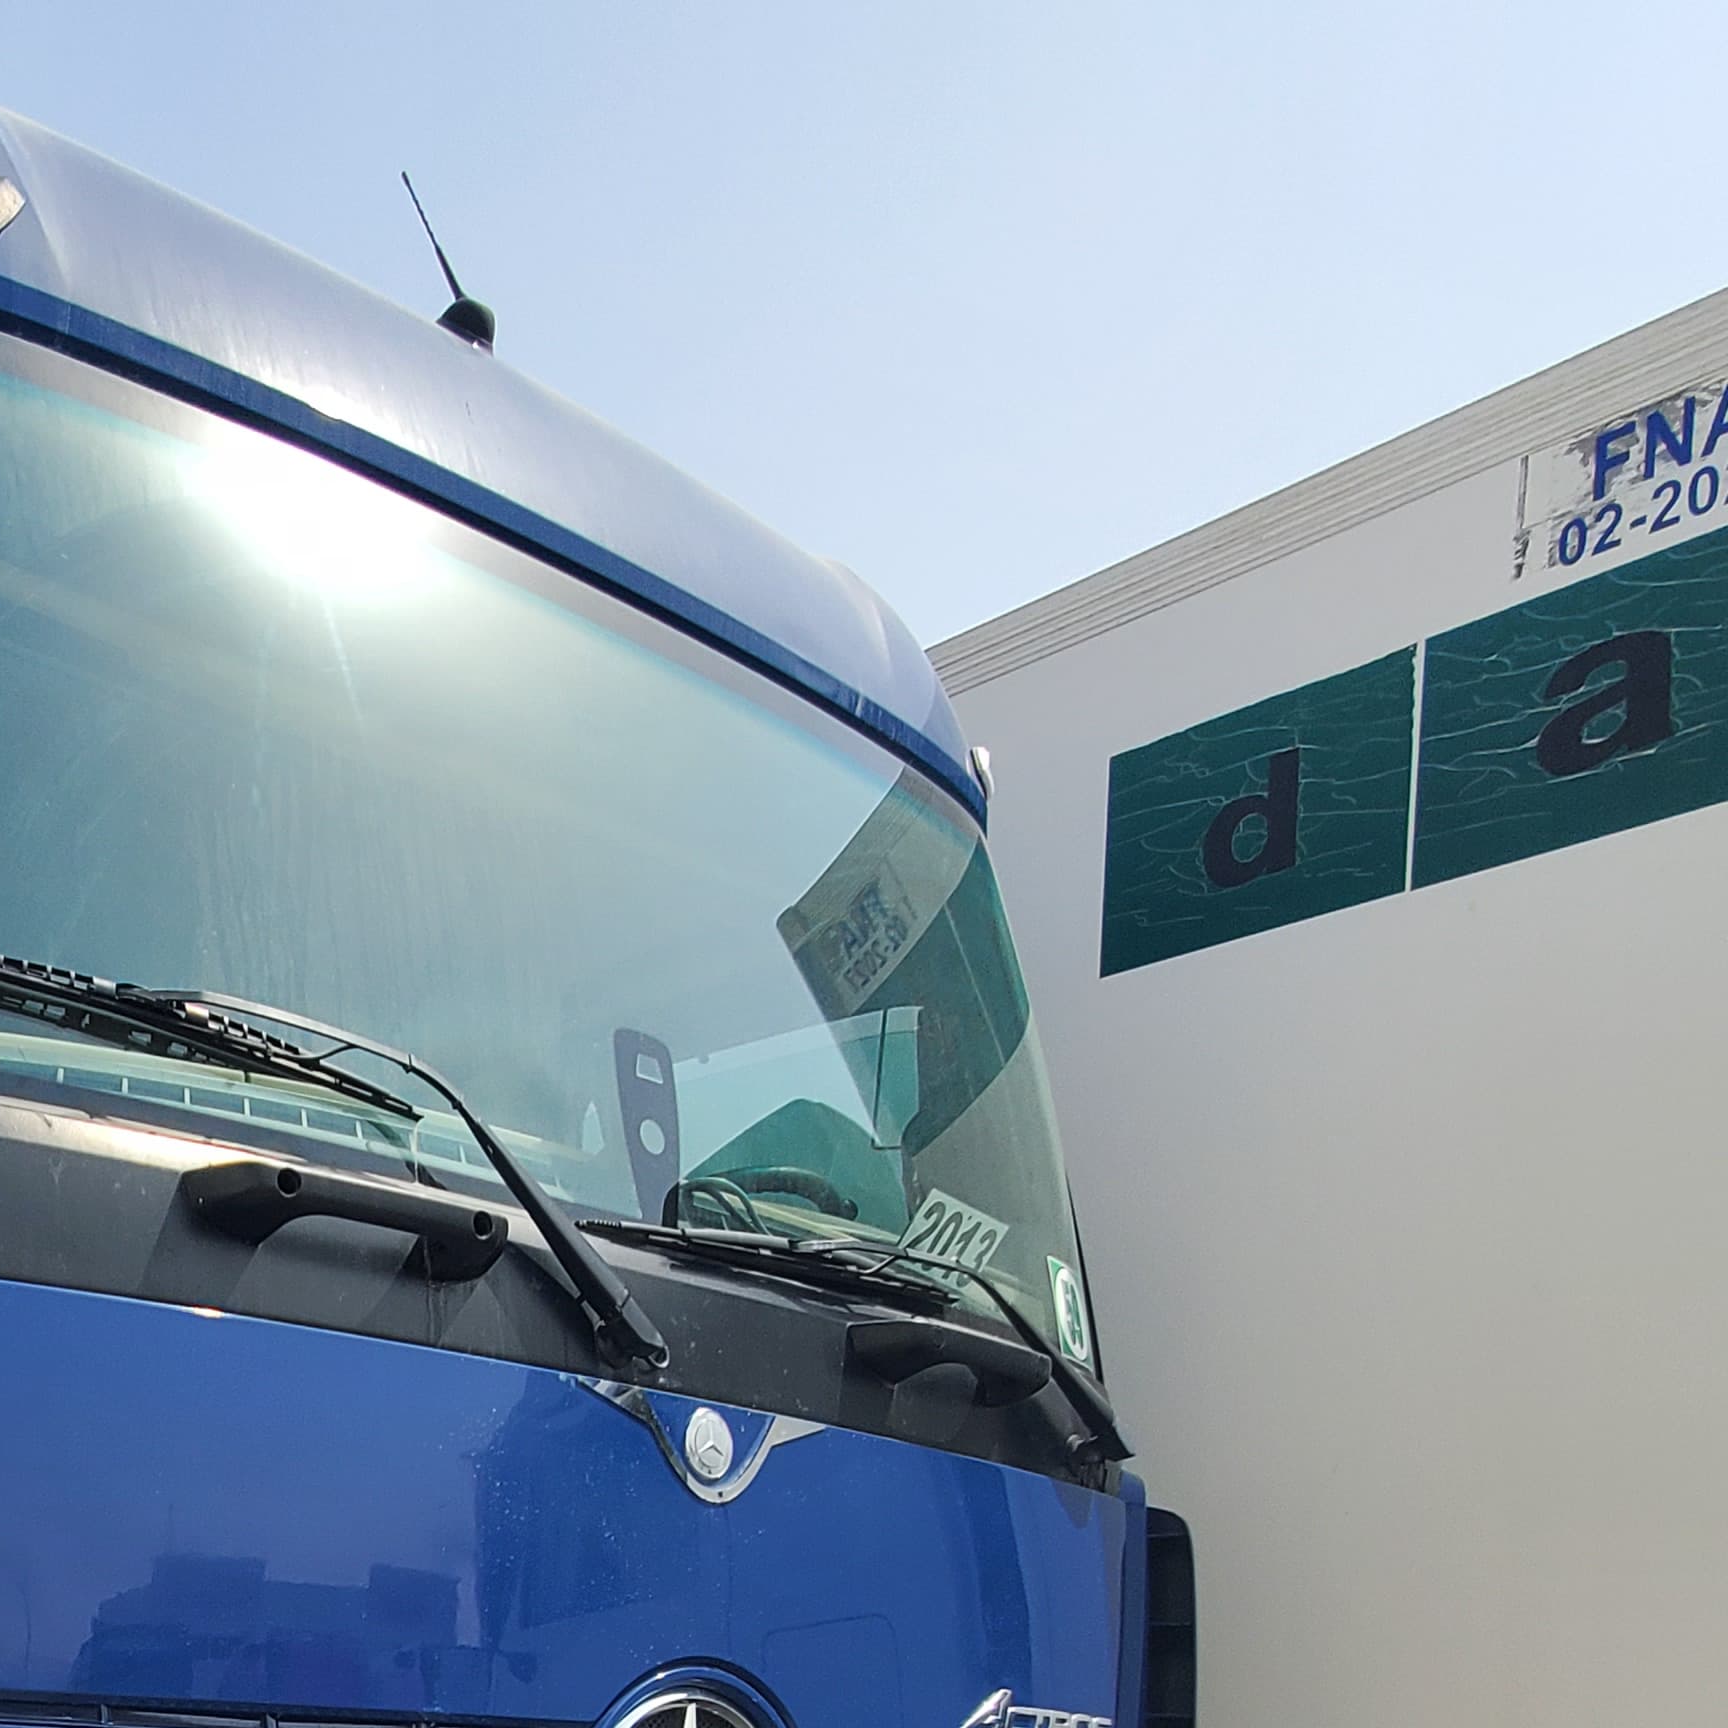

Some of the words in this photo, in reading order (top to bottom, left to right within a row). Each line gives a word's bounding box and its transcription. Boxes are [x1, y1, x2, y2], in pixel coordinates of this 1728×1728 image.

[1558, 465, 1728, 565] 02-20
[1202, 746, 1300, 889] d
[1536, 630, 1672, 776] a
[906, 1201, 998, 1287] 2013
